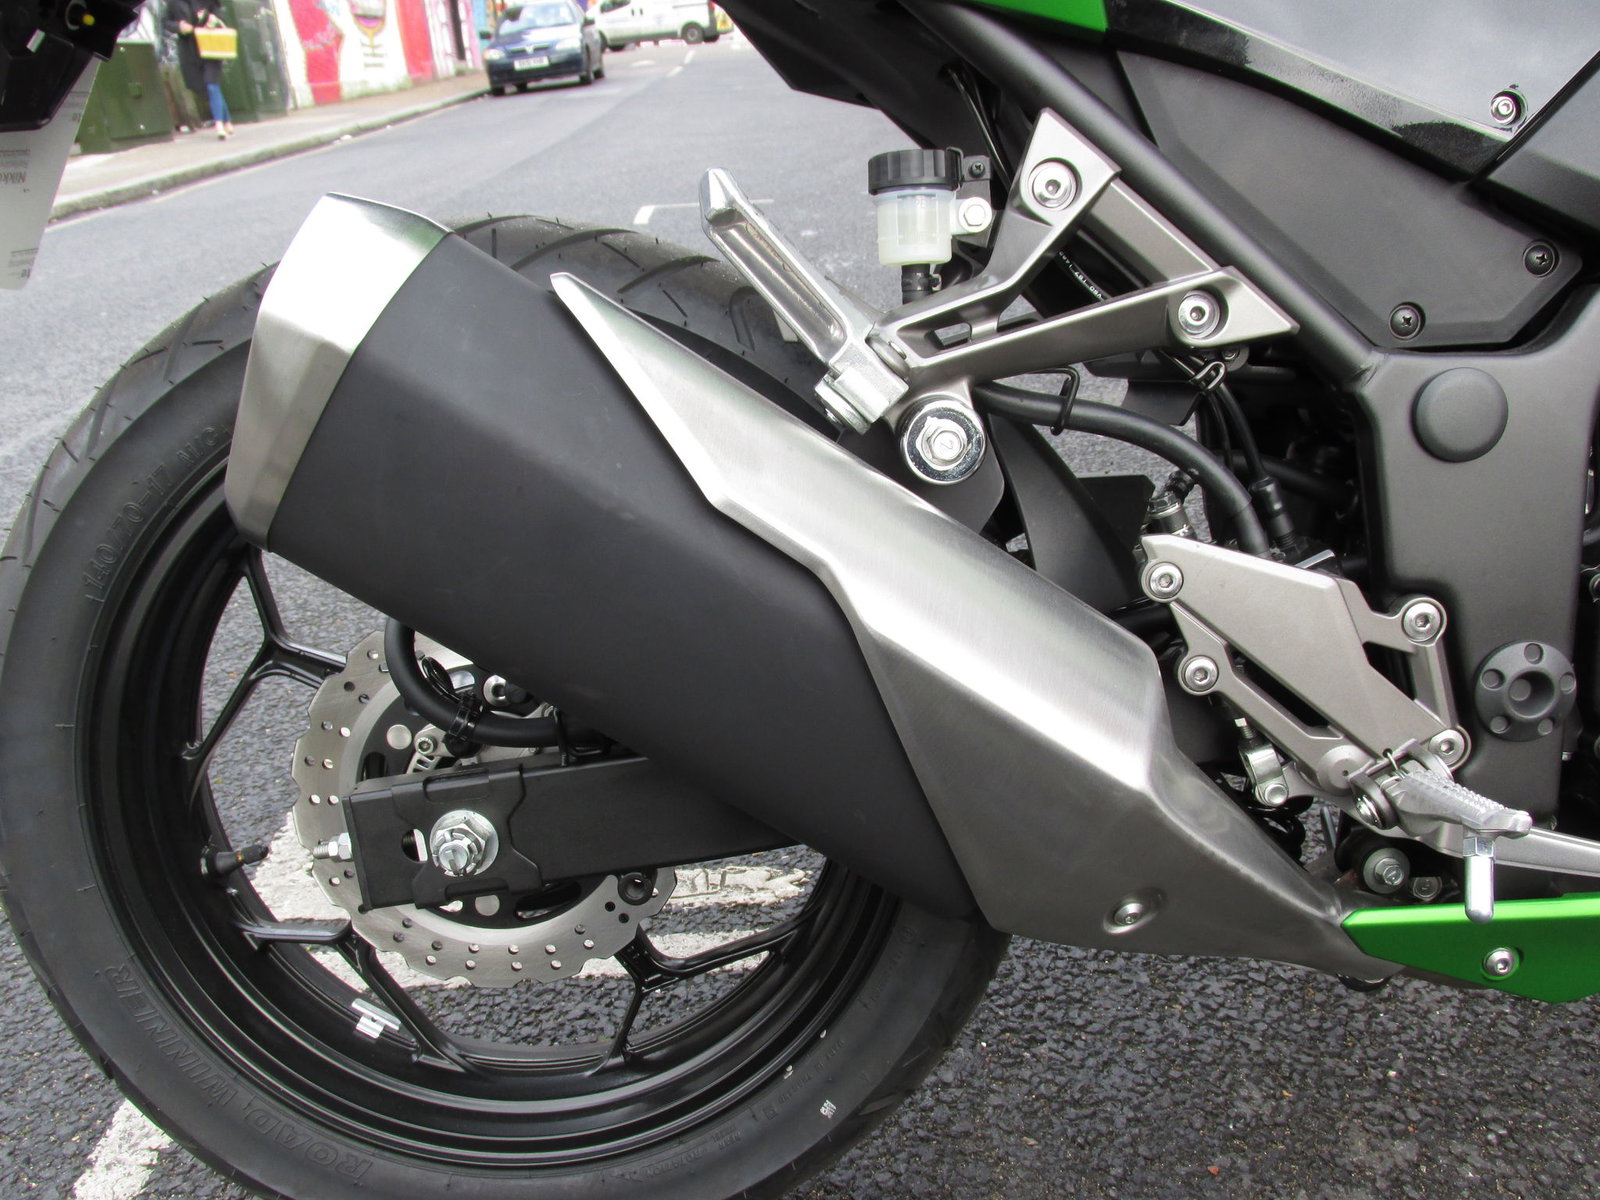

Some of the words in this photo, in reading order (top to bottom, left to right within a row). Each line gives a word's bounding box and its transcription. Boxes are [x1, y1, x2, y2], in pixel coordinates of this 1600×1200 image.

[82, 463, 171, 590] 140/70-17
[104, 963, 240, 1107] WINNER
[244, 1101, 373, 1179] ROAD
